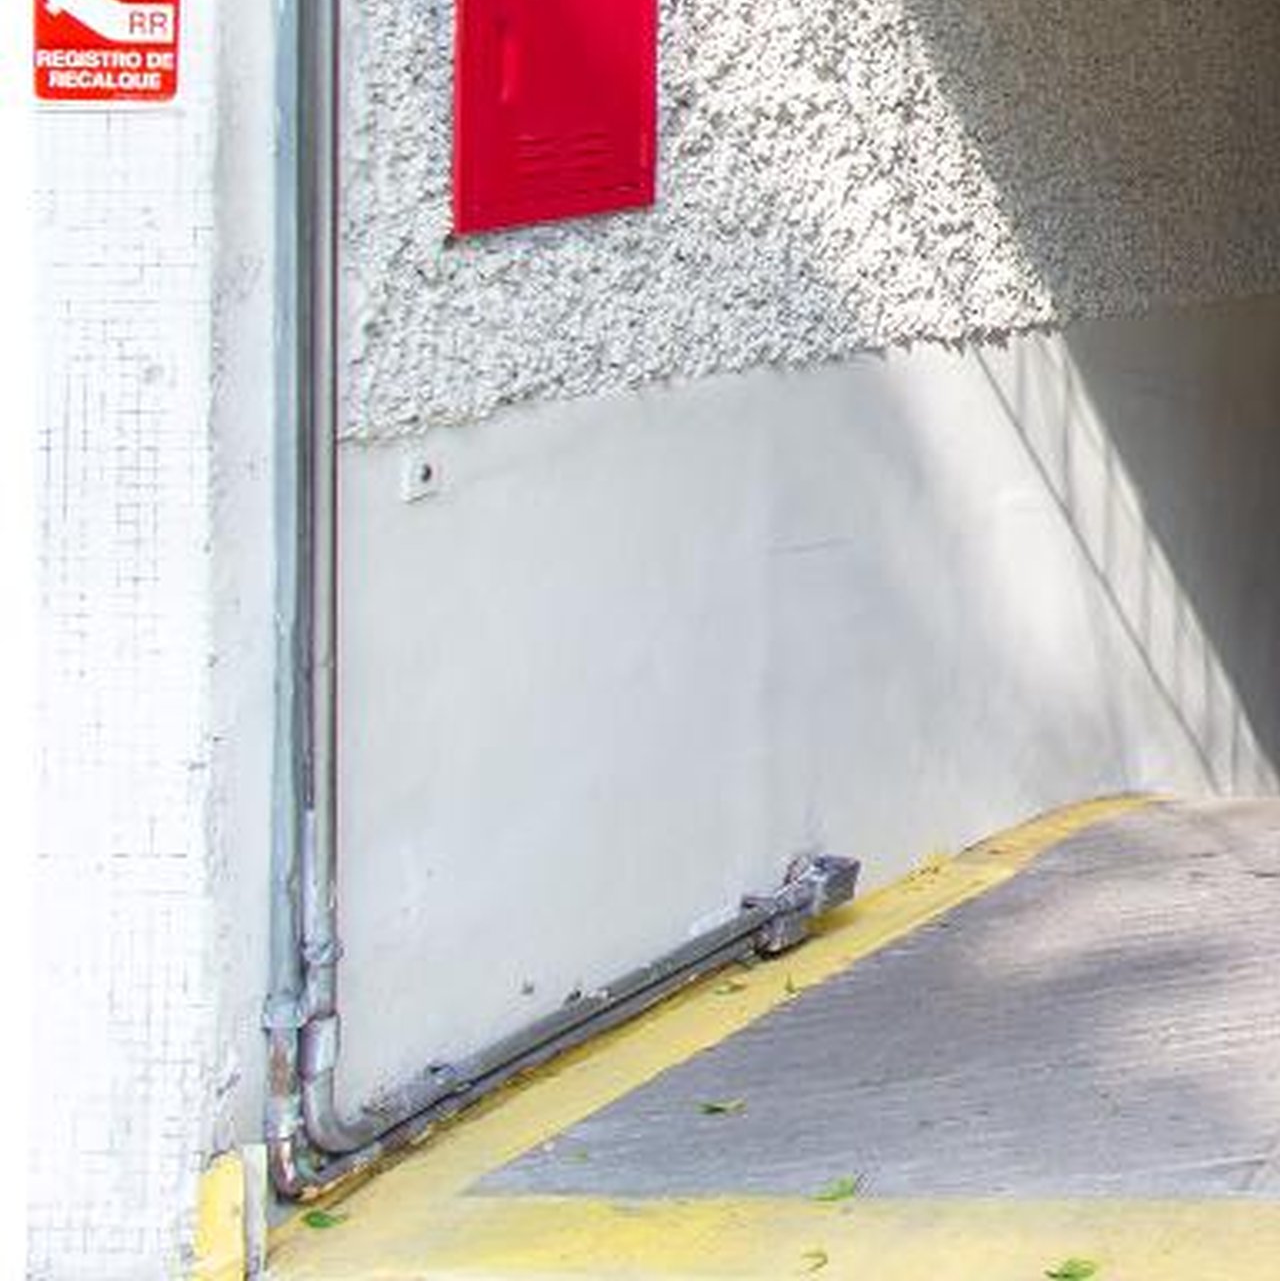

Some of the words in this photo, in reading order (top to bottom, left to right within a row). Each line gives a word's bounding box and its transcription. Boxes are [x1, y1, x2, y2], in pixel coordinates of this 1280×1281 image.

[128, 10, 168, 35] RR
[36, 50, 143, 68] REGISTRO
[147, 52, 174, 69] DE
[48, 71, 162, 89] RECALQUE
